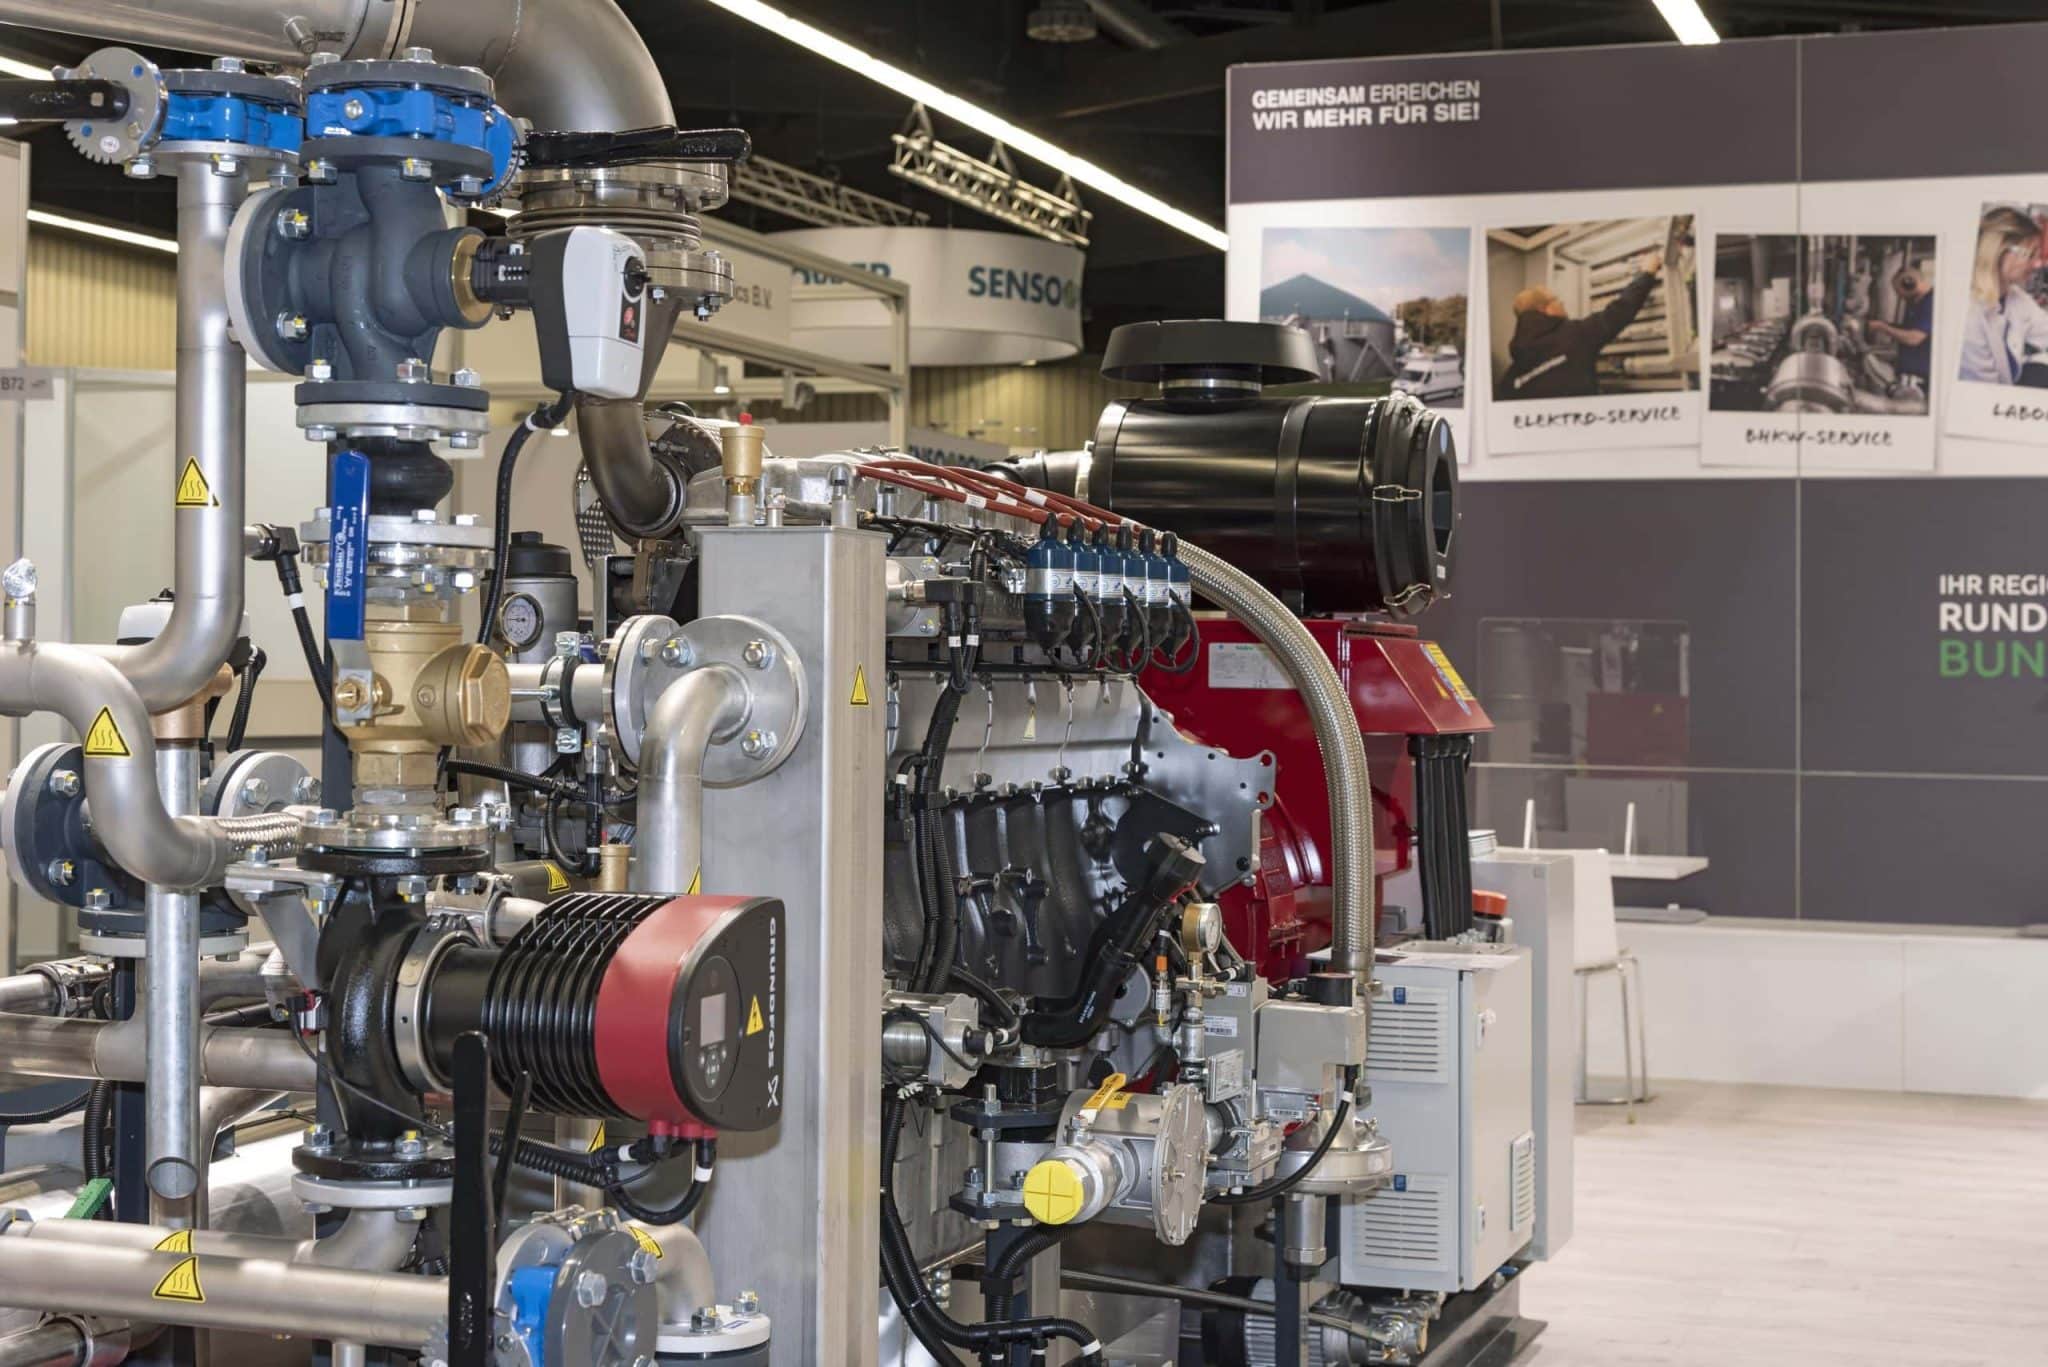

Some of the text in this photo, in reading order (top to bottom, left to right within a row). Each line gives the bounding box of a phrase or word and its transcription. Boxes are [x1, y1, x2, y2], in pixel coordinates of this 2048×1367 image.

[1252, 80, 1481, 109] GEMEINSAM ERREICHEN
[1252, 101, 1481, 130] WIR MEHR FÜR SIE!
[1513, 406, 1681, 429] ELEKTRO-SERVICE
[1992, 402, 2048, 422] LABO
[1746, 428, 1893, 447] BHKW-SERVICE
[1940, 574, 2048, 596] IHR REGI
[1940, 602, 2048, 632] RUND
[1940, 639, 2044, 678] BUN
[768, 916, 776, 1069] GRUNDFOS
